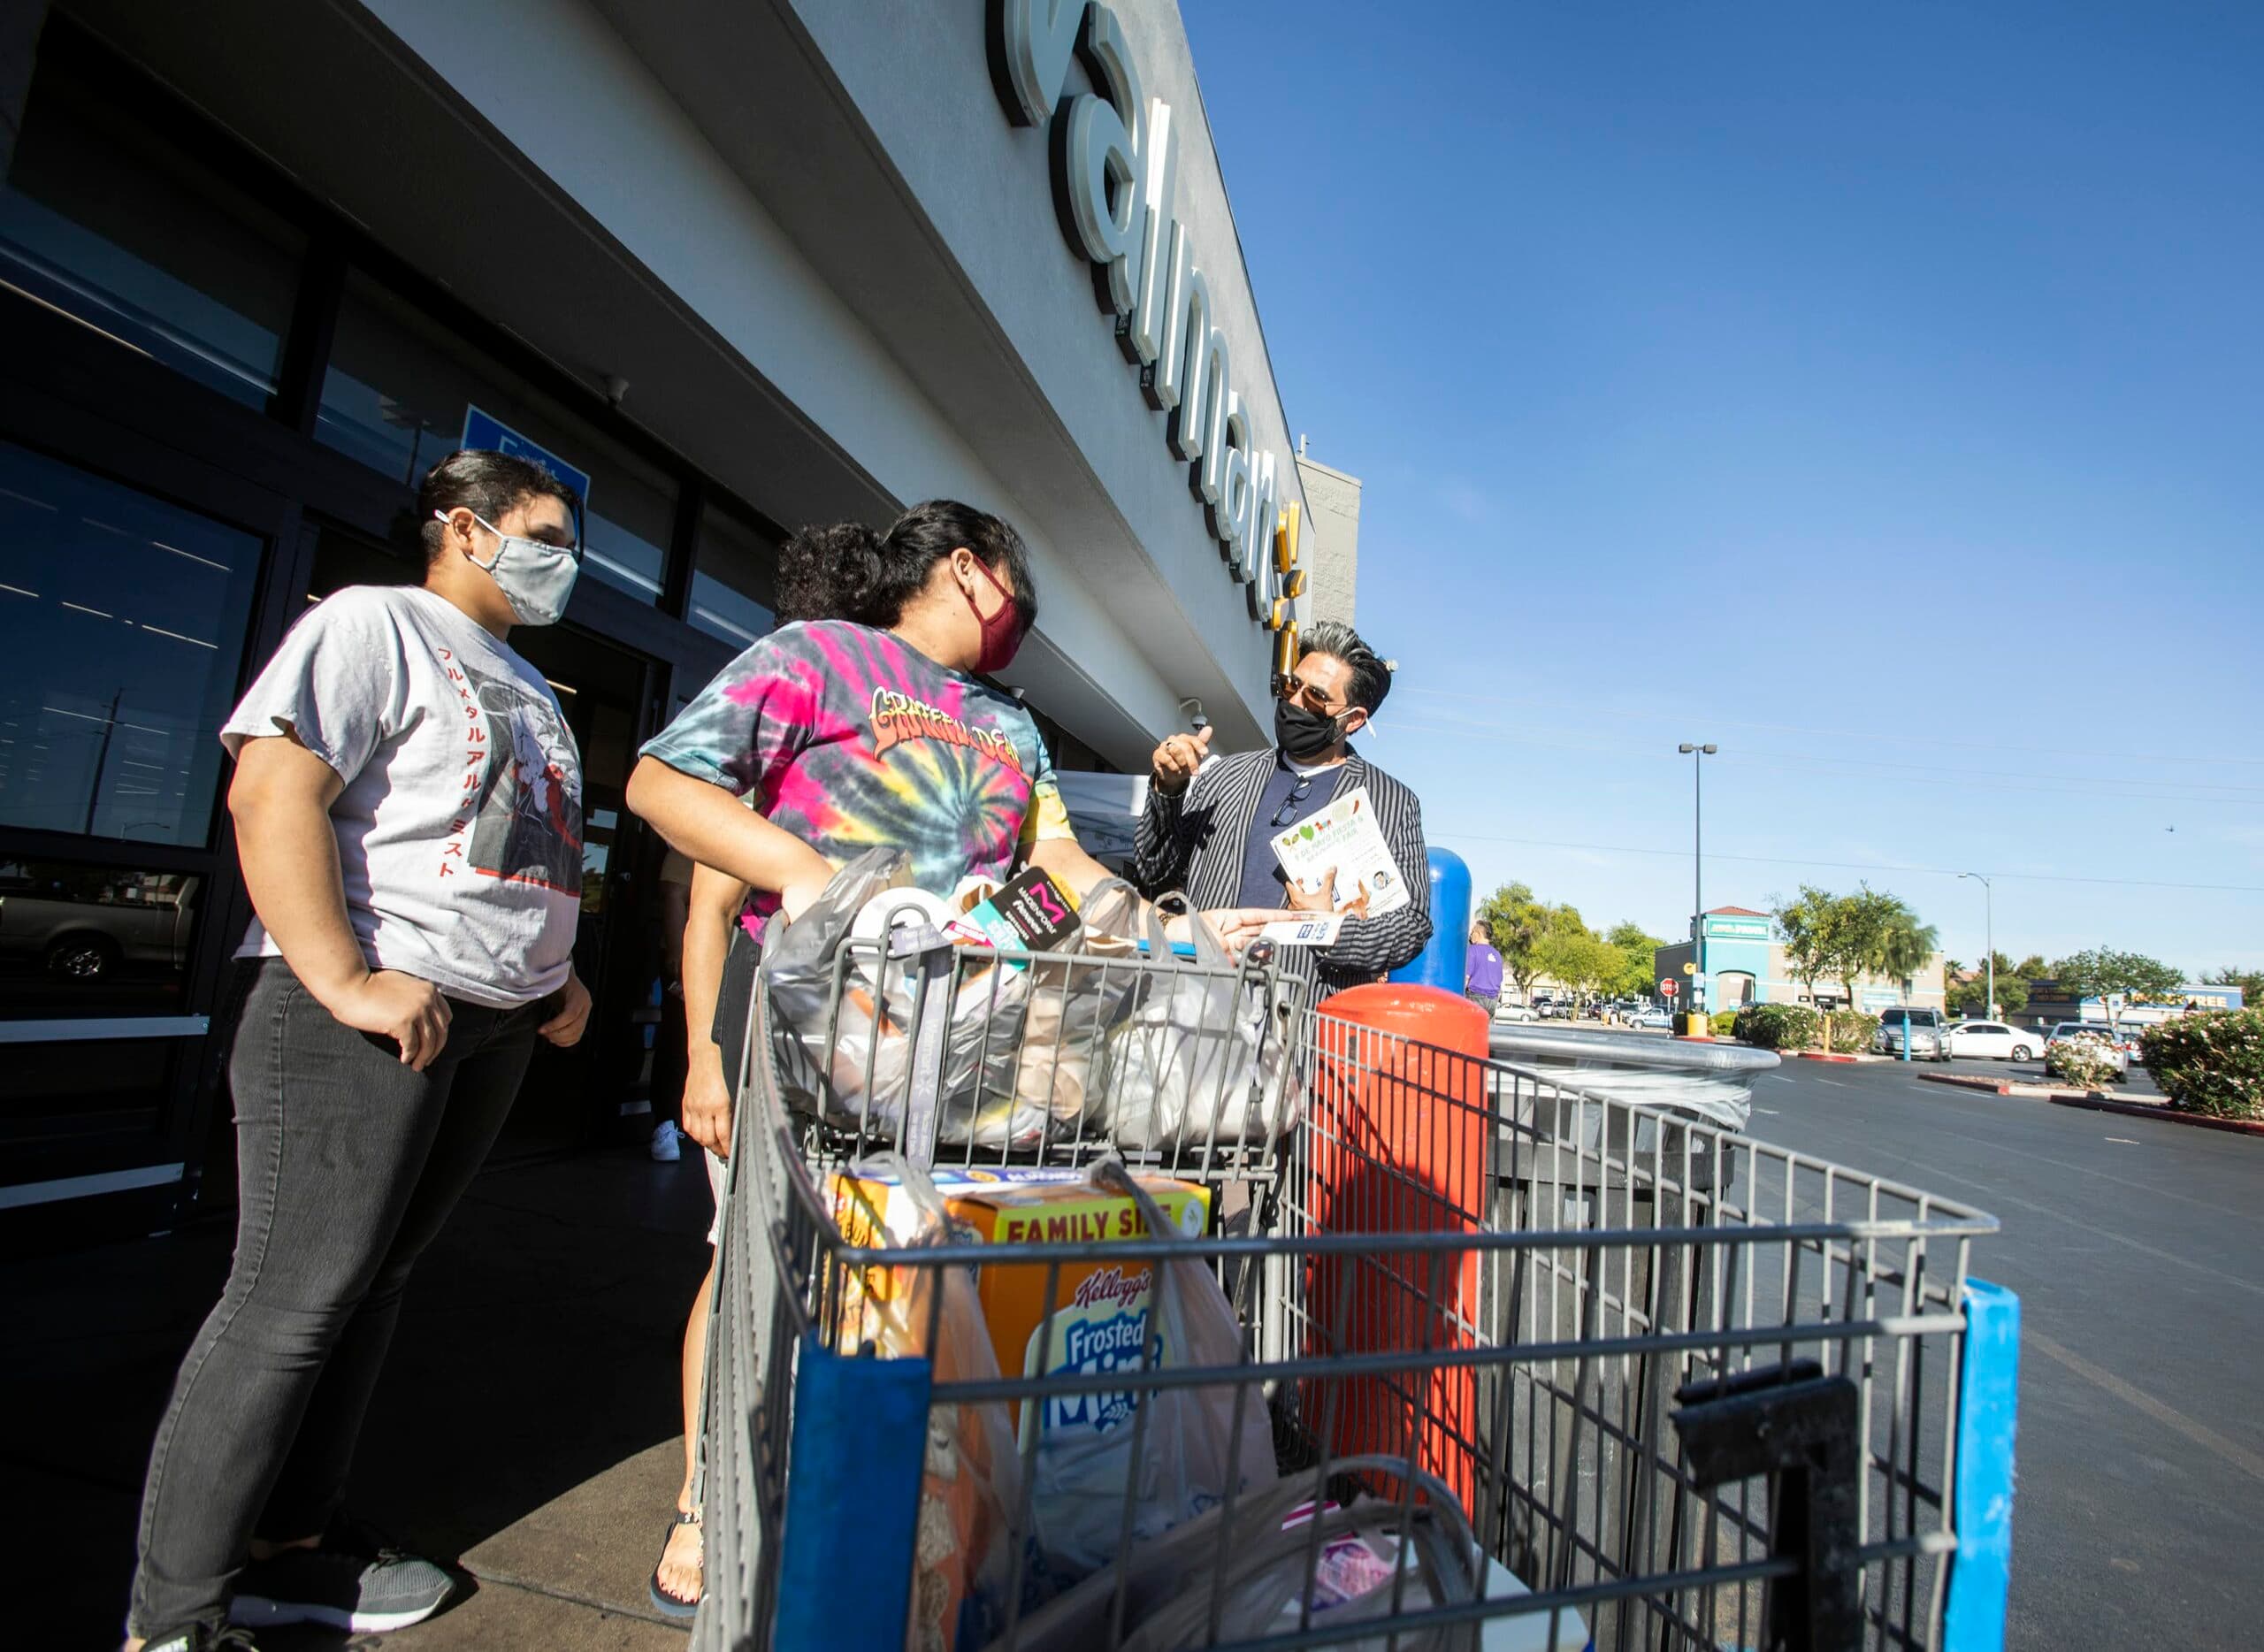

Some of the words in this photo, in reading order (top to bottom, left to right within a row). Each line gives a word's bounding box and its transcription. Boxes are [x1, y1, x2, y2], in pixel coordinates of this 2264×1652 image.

[868, 685, 971, 762] GRATEFUL
[1017, 886, 1058, 935] MAIDENFORM
[919, 1018, 939, 1077] Walmart
[1006, 1210, 1110, 1243] FAMILY
[1075, 1267, 1151, 1309] Kellogg's
[1070, 1312, 1148, 1366] Frosted
